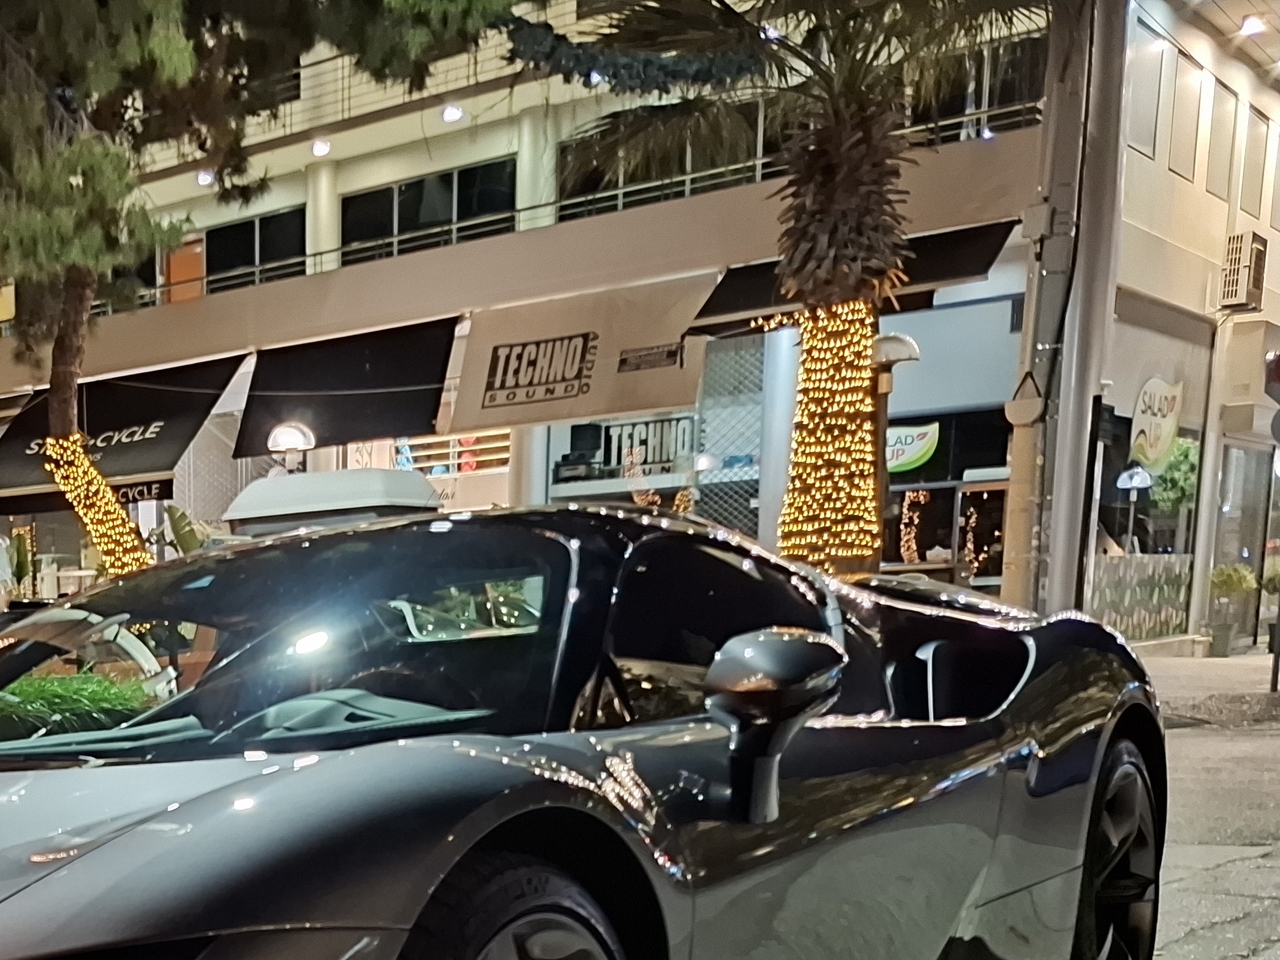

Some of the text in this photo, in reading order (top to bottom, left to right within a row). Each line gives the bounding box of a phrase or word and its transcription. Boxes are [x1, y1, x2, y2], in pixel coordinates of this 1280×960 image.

[493, 336, 584, 390] TECHNO
[580, 331, 600, 395] AUDIO
[488, 383, 575, 403] SOUND
[1141, 390, 1168, 418] SALAD
[610, 418, 693, 467] TECHNO
[887, 434, 915, 448] LAD
[120, 484, 160, 502] CYCLE
